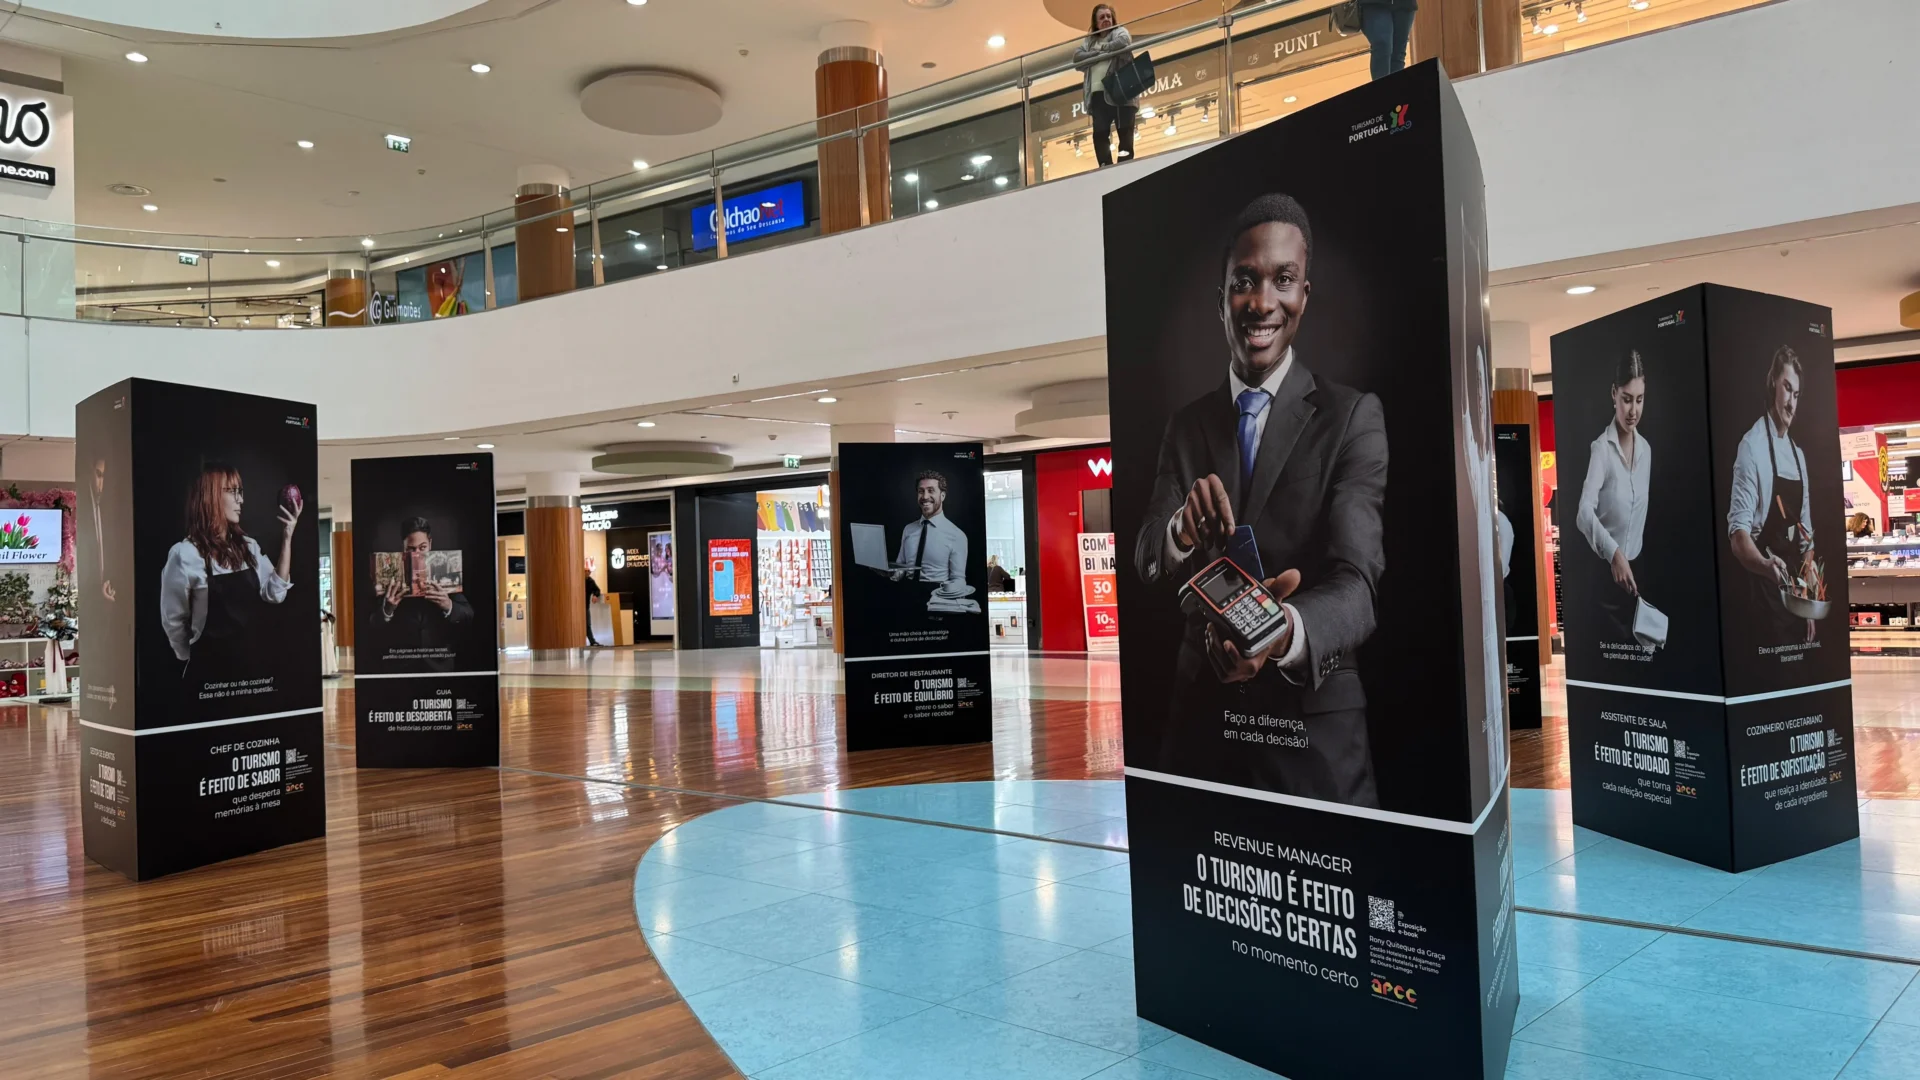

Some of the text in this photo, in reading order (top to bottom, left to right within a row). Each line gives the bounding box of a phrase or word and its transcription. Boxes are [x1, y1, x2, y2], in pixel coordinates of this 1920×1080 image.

[1273, 31, 1321, 58] PUNT
[1351, 114, 1384, 132] TURISMO DE
[1348, 123, 1389, 144] PORTUGAL
[1082, 537, 1107, 552] COM
[12, 550, 48, 560] Flower
[1093, 581, 1111, 595] 30
[1095, 613, 1116, 625] 10%
[1610, 642, 1634, 650] delicadeza
[1758, 646, 1771, 654] Elevo
[1609, 652, 1629, 660] plenitude
[909, 669, 952, 677] RESTAURANTE
[204, 682, 229, 690] Cozinhar
[249, 676, 274, 685] cozinhar?
[914, 678, 953, 690] O TURISMO
[199, 692, 214, 700] Essa
[413, 699, 453, 710] O TURISMO
[874, 692, 879, 704] É
[880, 692, 901, 704] FEITO
[902, 692, 913, 702] DE
[914, 688, 954, 702] EQUILÍBRIO
[368, 710, 374, 722] É
[375, 712, 394, 722] FEITO
[395, 711, 405, 722] DE
[406, 710, 453, 722] DESCOBERTA
[1224, 710, 1307, 732] Faço a diferença,
[1600, 711, 1667, 729] ASSISTENTE DE SALA
[1746, 714, 1823, 737] COZINHEIRO VEGETARIANO
[210, 737, 280, 755] CHEF DE COZINHA
[1223, 729, 1309, 748] em cada decisão!
[1624, 730, 1669, 754] O TURISMO
[1790, 736, 1796, 754] O
[1796, 730, 1825, 753] TURISMO
[232, 750, 281, 772] O TURISMO
[1594, 741, 1600, 761] É
[1600, 745, 1621, 765] FEITO
[1622, 750, 1633, 768] DE
[1634, 752, 1670, 776] CUIDADO
[1740, 764, 1746, 787] É
[1747, 765, 1769, 786] FEITO
[1770, 761, 1779, 781] DE
[1780, 750, 1825, 778] SOFISTICAÇÃO
[199, 777, 206, 797] É
[208, 776, 235, 795] FEITO
[237, 773, 249, 790] DE
[251, 768, 281, 787] SABOR
[1637, 777, 1671, 792] que torna
[1764, 776, 1828, 800] que realça identidade
[232, 794, 248, 805] que
[249, 788, 281, 801] desperta
[1602, 781, 1672, 805] cada refeição especial
[1775, 789, 1828, 810] de cada ingrediente
[214, 800, 281, 819] memórias à mesa
[1214, 831, 1352, 874] REVENUE MANAGER
[1196, 853, 1355, 919] O TURISMO É FEITO
[1183, 883, 1357, 959] DE DECISÕES CERTAS
[1397, 921, 1427, 933] Exposição
[1397, 930, 1419, 938] e-book
[1369, 935, 1446, 961] Rony Quiteque da Graça
[1369, 945, 1441, 968] Gestão Hoteleira Alojamento
[1232, 940, 1359, 988] no momento certo
[1370, 951, 1385, 960] Escola
[1392, 957, 1414, 968] Hotelaria
[1418, 964, 1439, 974] Turismo
[1377, 960, 1413, 974] Douro-Lamego
